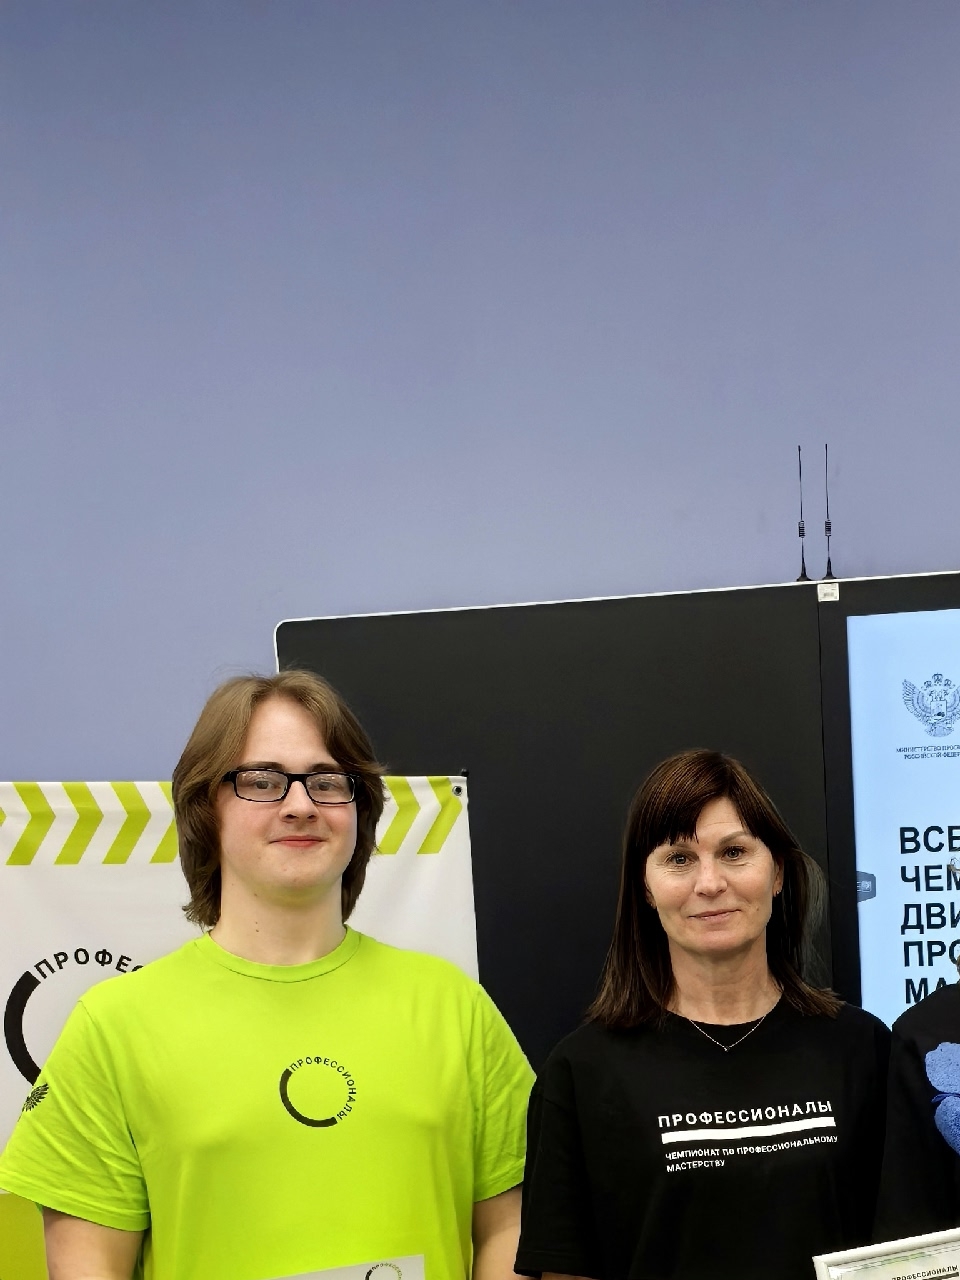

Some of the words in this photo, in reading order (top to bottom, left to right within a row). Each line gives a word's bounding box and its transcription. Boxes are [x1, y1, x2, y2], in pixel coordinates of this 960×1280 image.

[290, 1056, 357, 1120] ПРОФЕССИОНАЛЫ
[658, 1100, 832, 1128] ПРОФЕССИОНАЛЫ
[665, 1147, 720, 1161] ЧЕМПИОНАТ
[736, 1135, 838, 1155] ПРОФЕССИОНАЛЬНОМУ
[666, 1159, 725, 1173] МАСТЕРСТВУ
